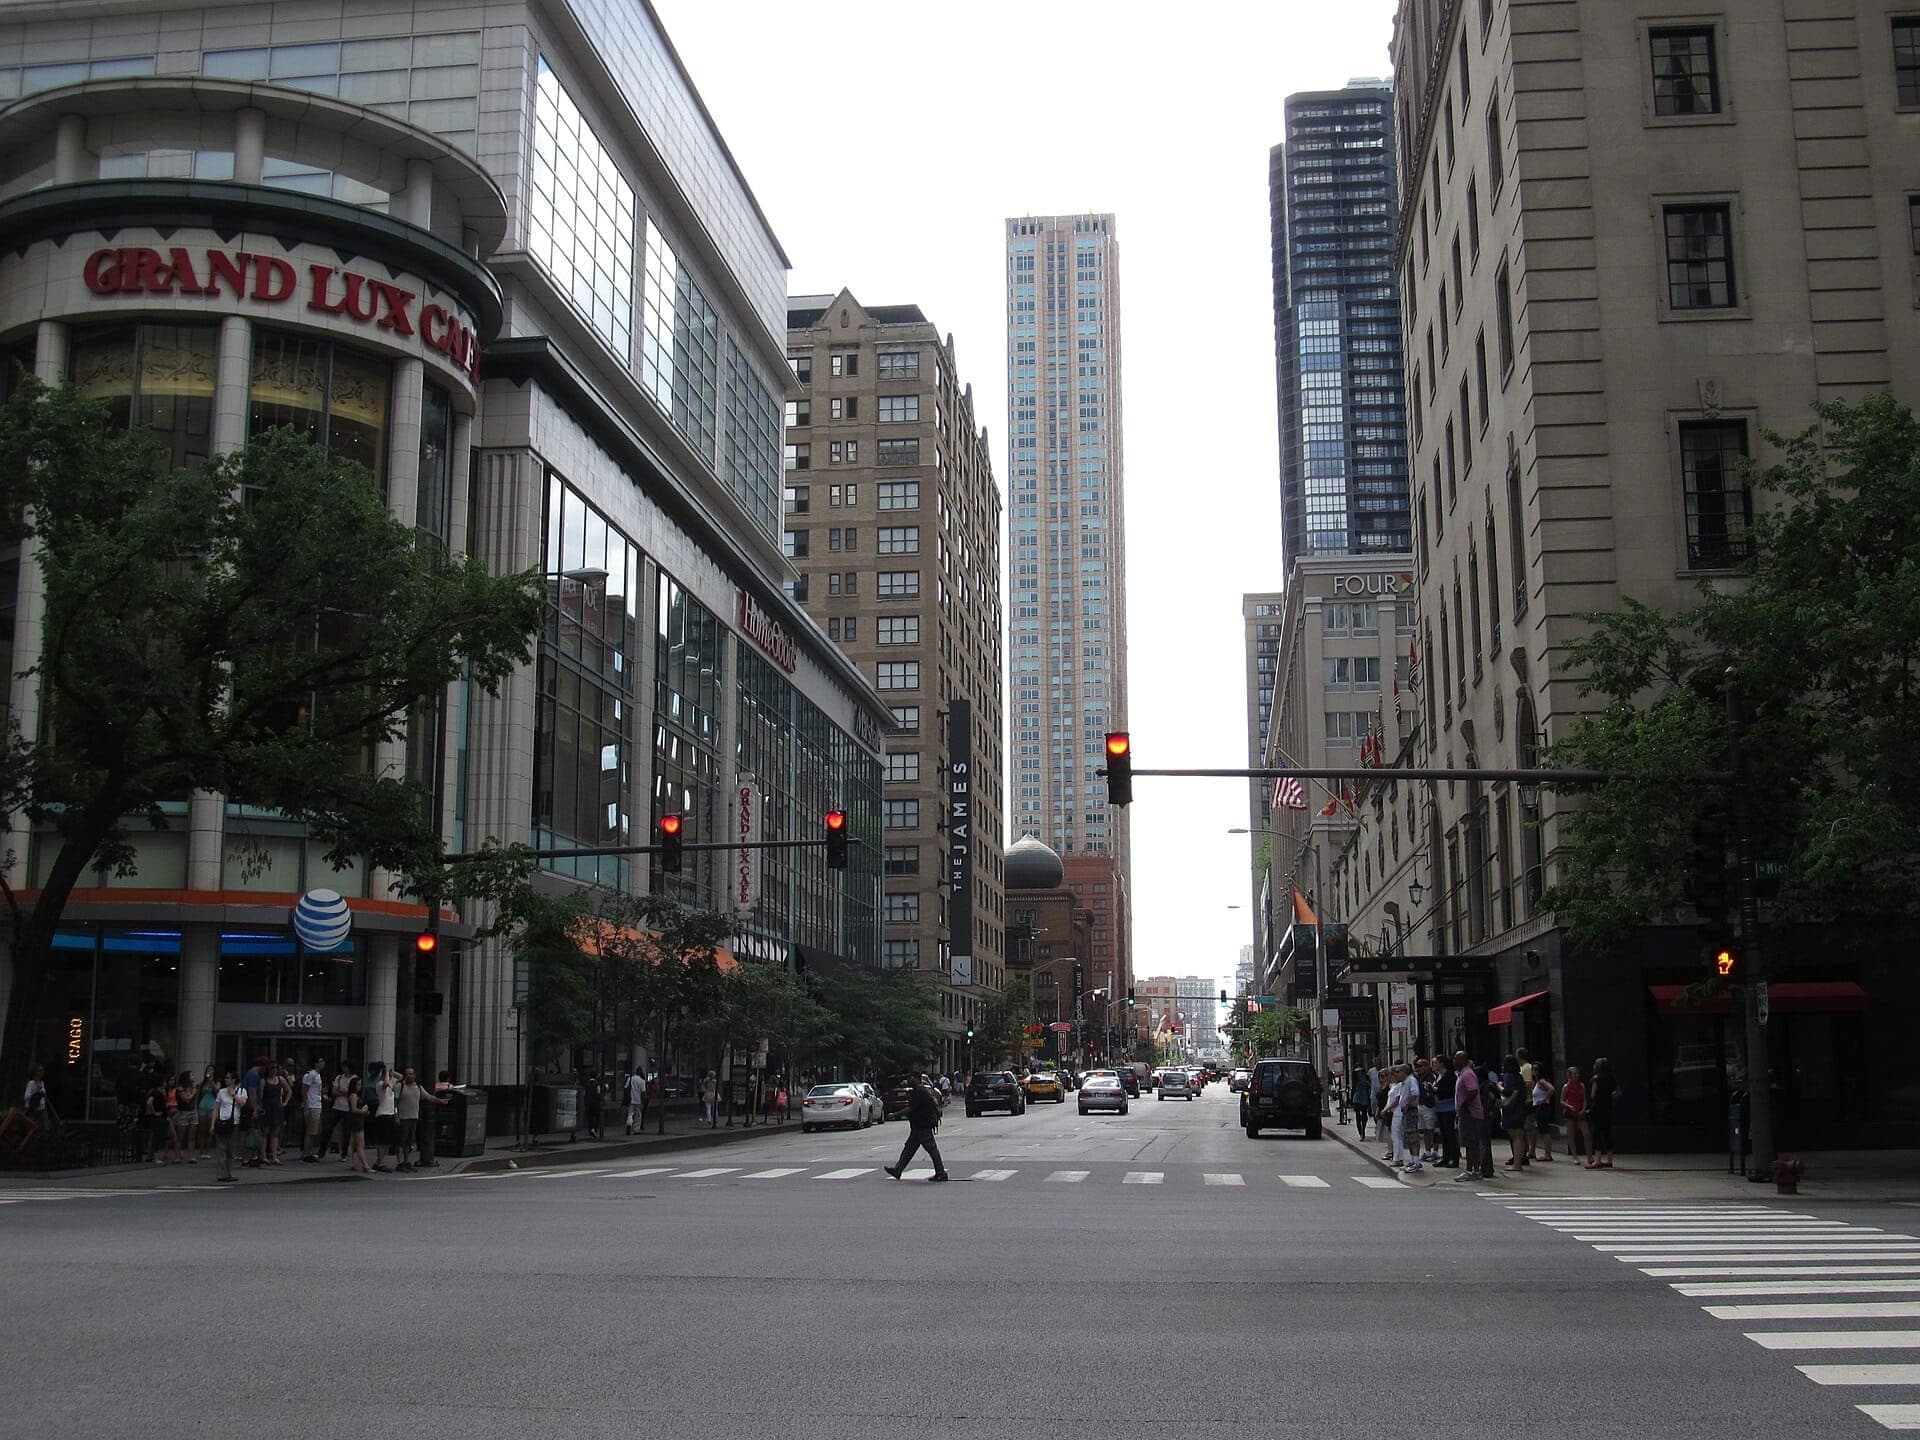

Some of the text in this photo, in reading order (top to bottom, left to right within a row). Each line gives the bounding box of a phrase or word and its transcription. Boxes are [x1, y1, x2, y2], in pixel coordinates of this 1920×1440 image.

[83, 247, 297, 302] GRAND
[307, 263, 416, 336] LUX
[1334, 574, 1398, 594] FOUR
[740, 787, 751, 834] GRAND
[953, 763, 968, 892] THE JAMES
[740, 865, 751, 904] CAFE
[285, 1011, 323, 1028] at&t
